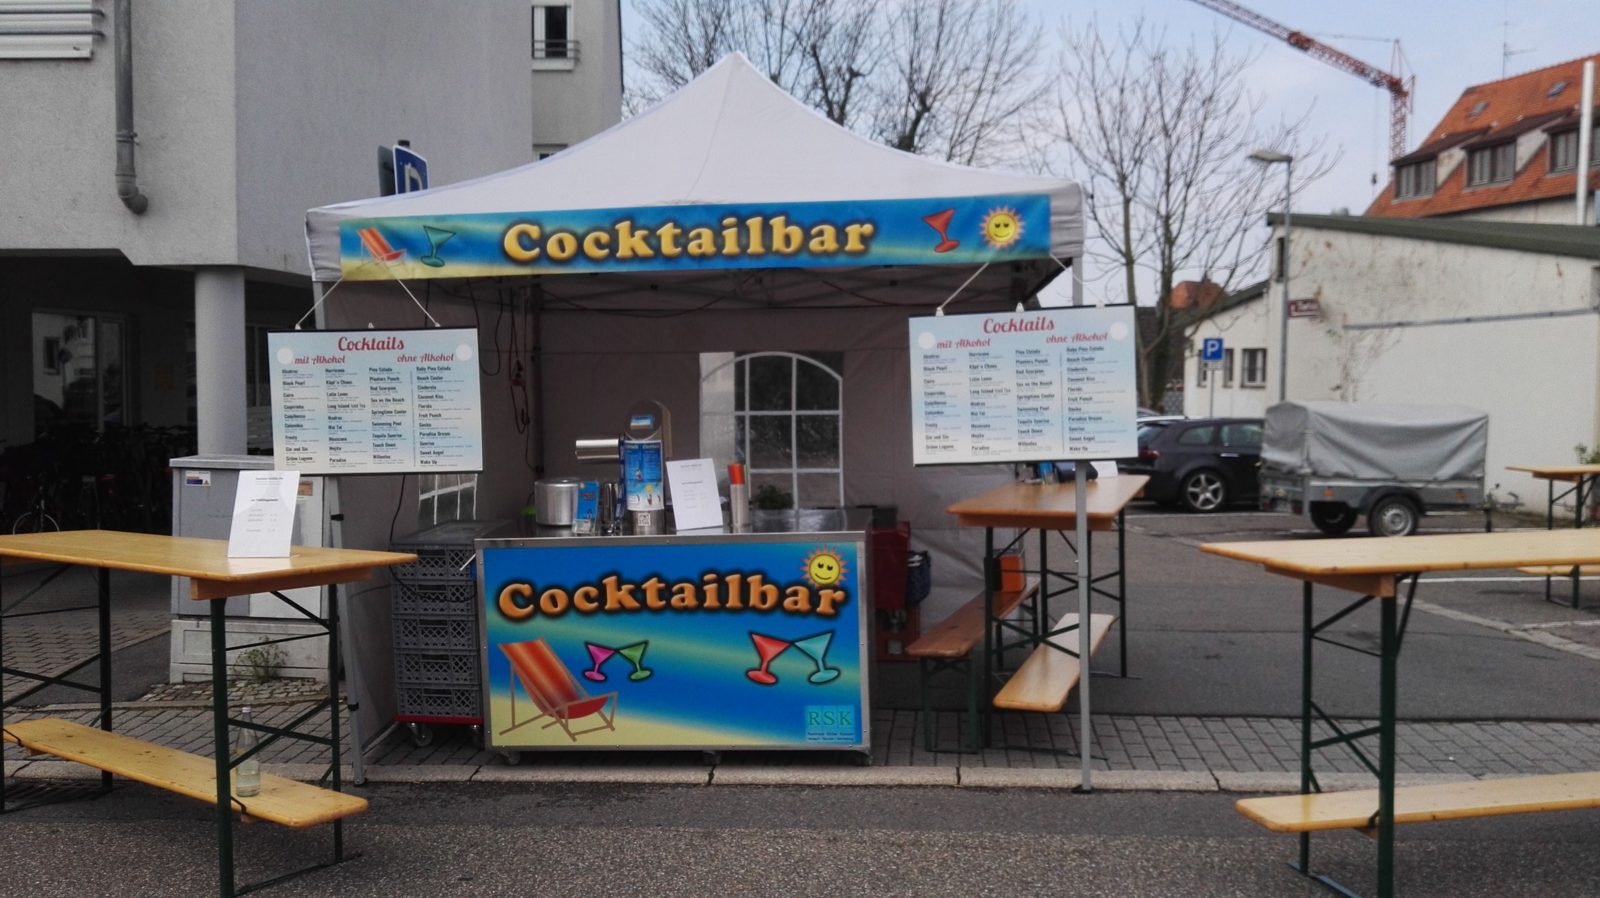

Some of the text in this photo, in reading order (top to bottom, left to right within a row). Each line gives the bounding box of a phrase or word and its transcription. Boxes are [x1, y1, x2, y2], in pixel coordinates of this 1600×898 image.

[503, 215, 874, 262] Cocktailbar
[983, 316, 1055, 334] Cocktails
[337, 336, 405, 351] Cocktails
[937, 339, 991, 348] mit Alkohol
[1071, 332, 1108, 342] Alkohol
[1206, 340, 1219, 357] P
[312, 356, 345, 364] Alkohol
[420, 354, 454, 362] Alkohol
[498, 573, 846, 620] Cocktailbar
[808, 711, 853, 726] RSK
